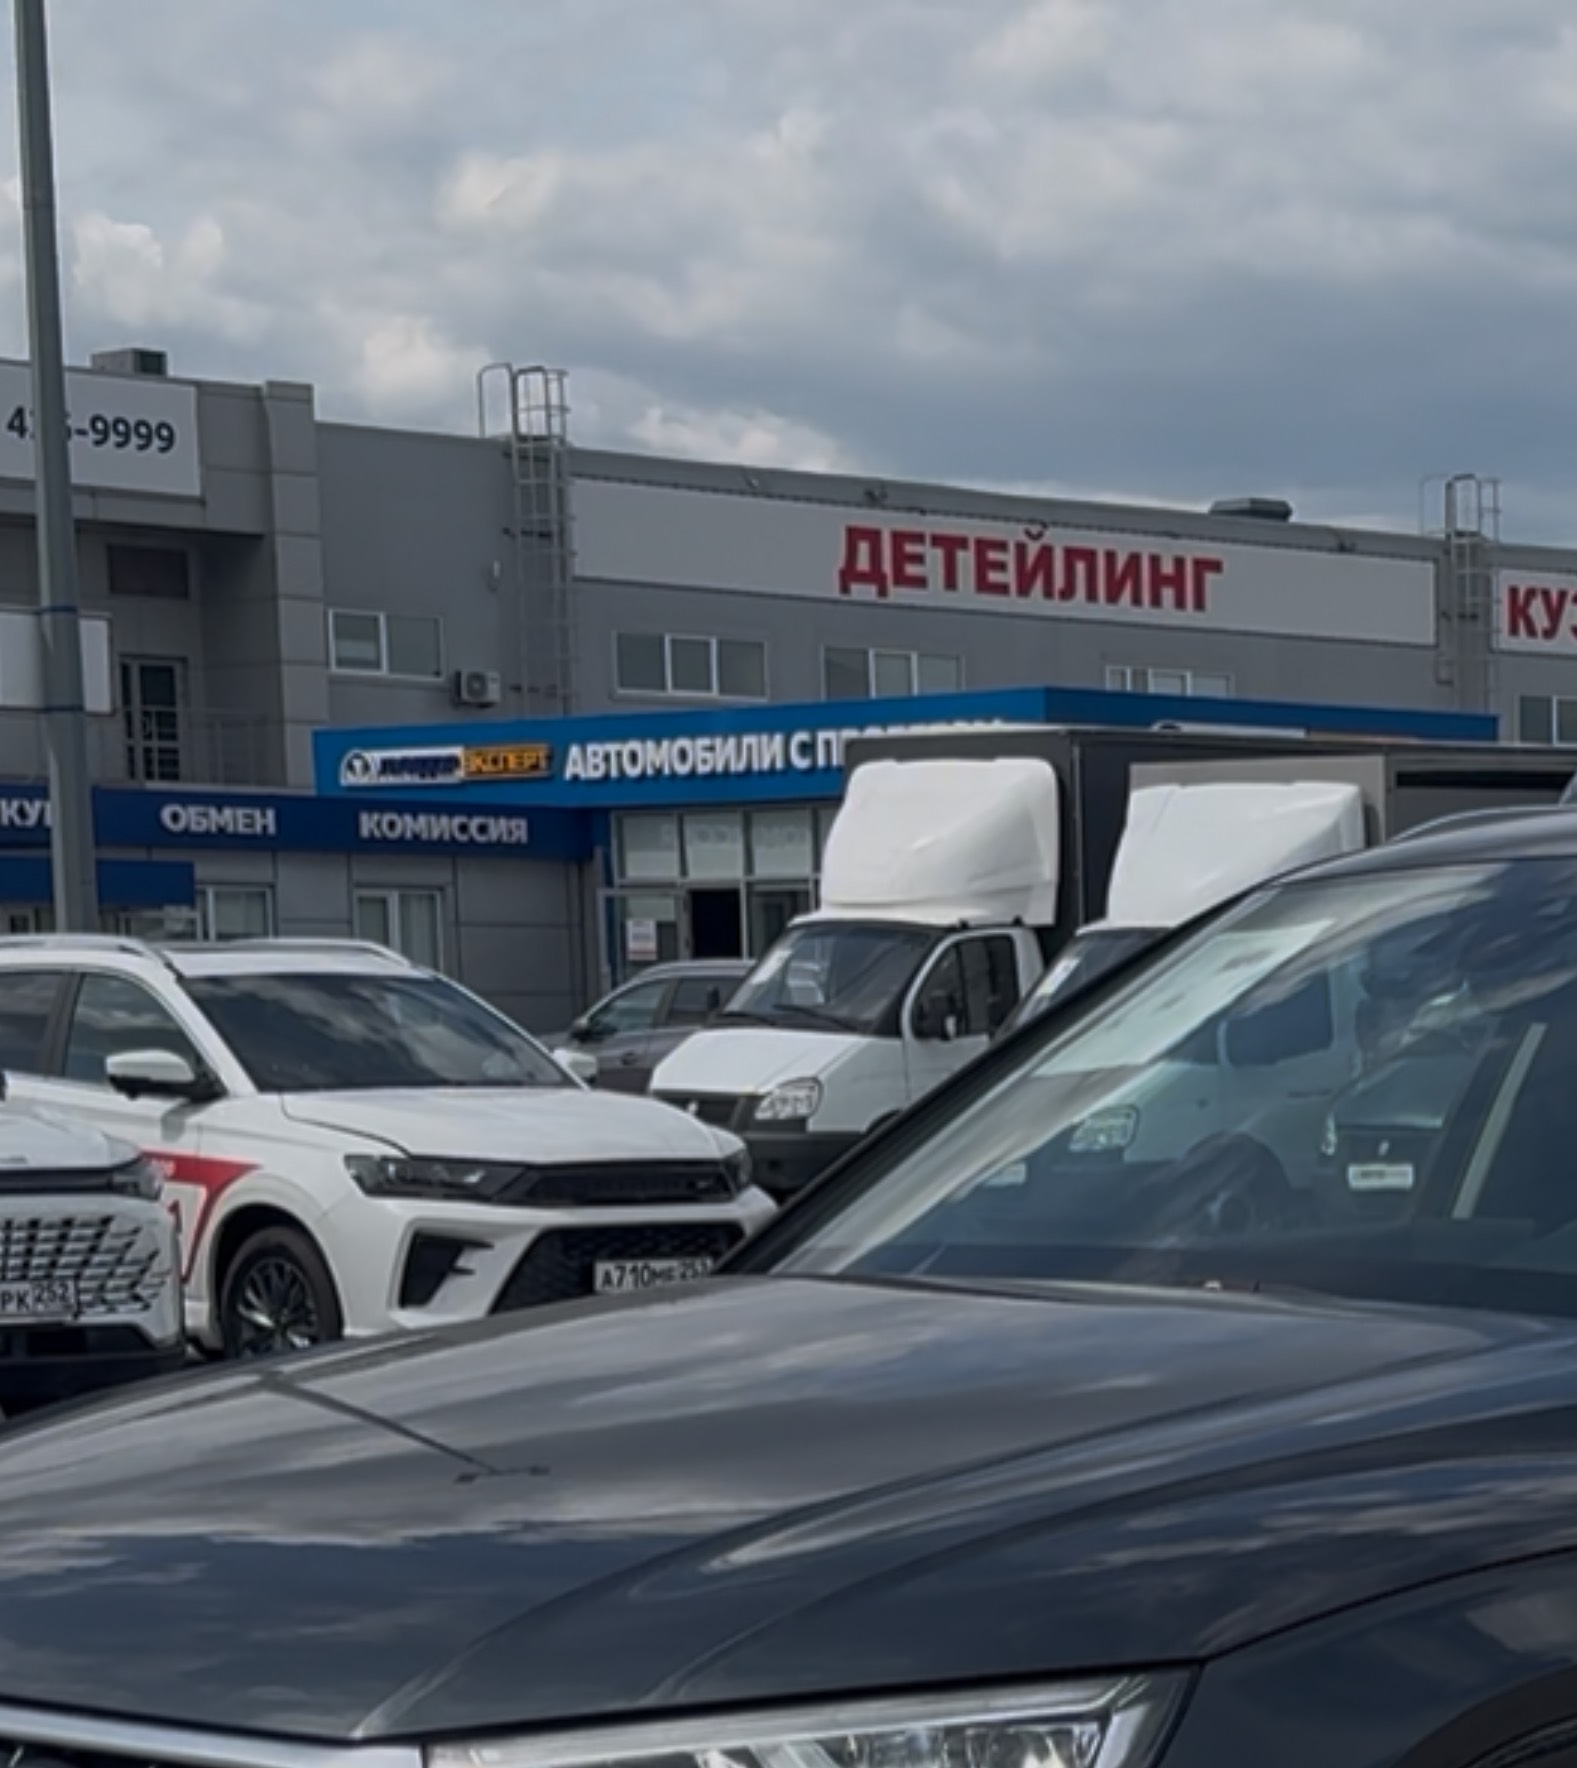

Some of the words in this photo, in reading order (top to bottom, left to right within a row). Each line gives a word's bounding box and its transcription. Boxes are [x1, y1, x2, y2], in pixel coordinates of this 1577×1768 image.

[6, 405, 176, 454] 4-9999
[838, 520, 1224, 612] ДЕТЕЙЛИНГ
[564, 731, 784, 782] АВТОМОБИЛИ
[789, 730, 813, 769] С
[161, 803, 276, 835] ОБМЕН
[359, 811, 528, 844] КОМИССИЯ
[33, 1281, 70, 1299] 252
